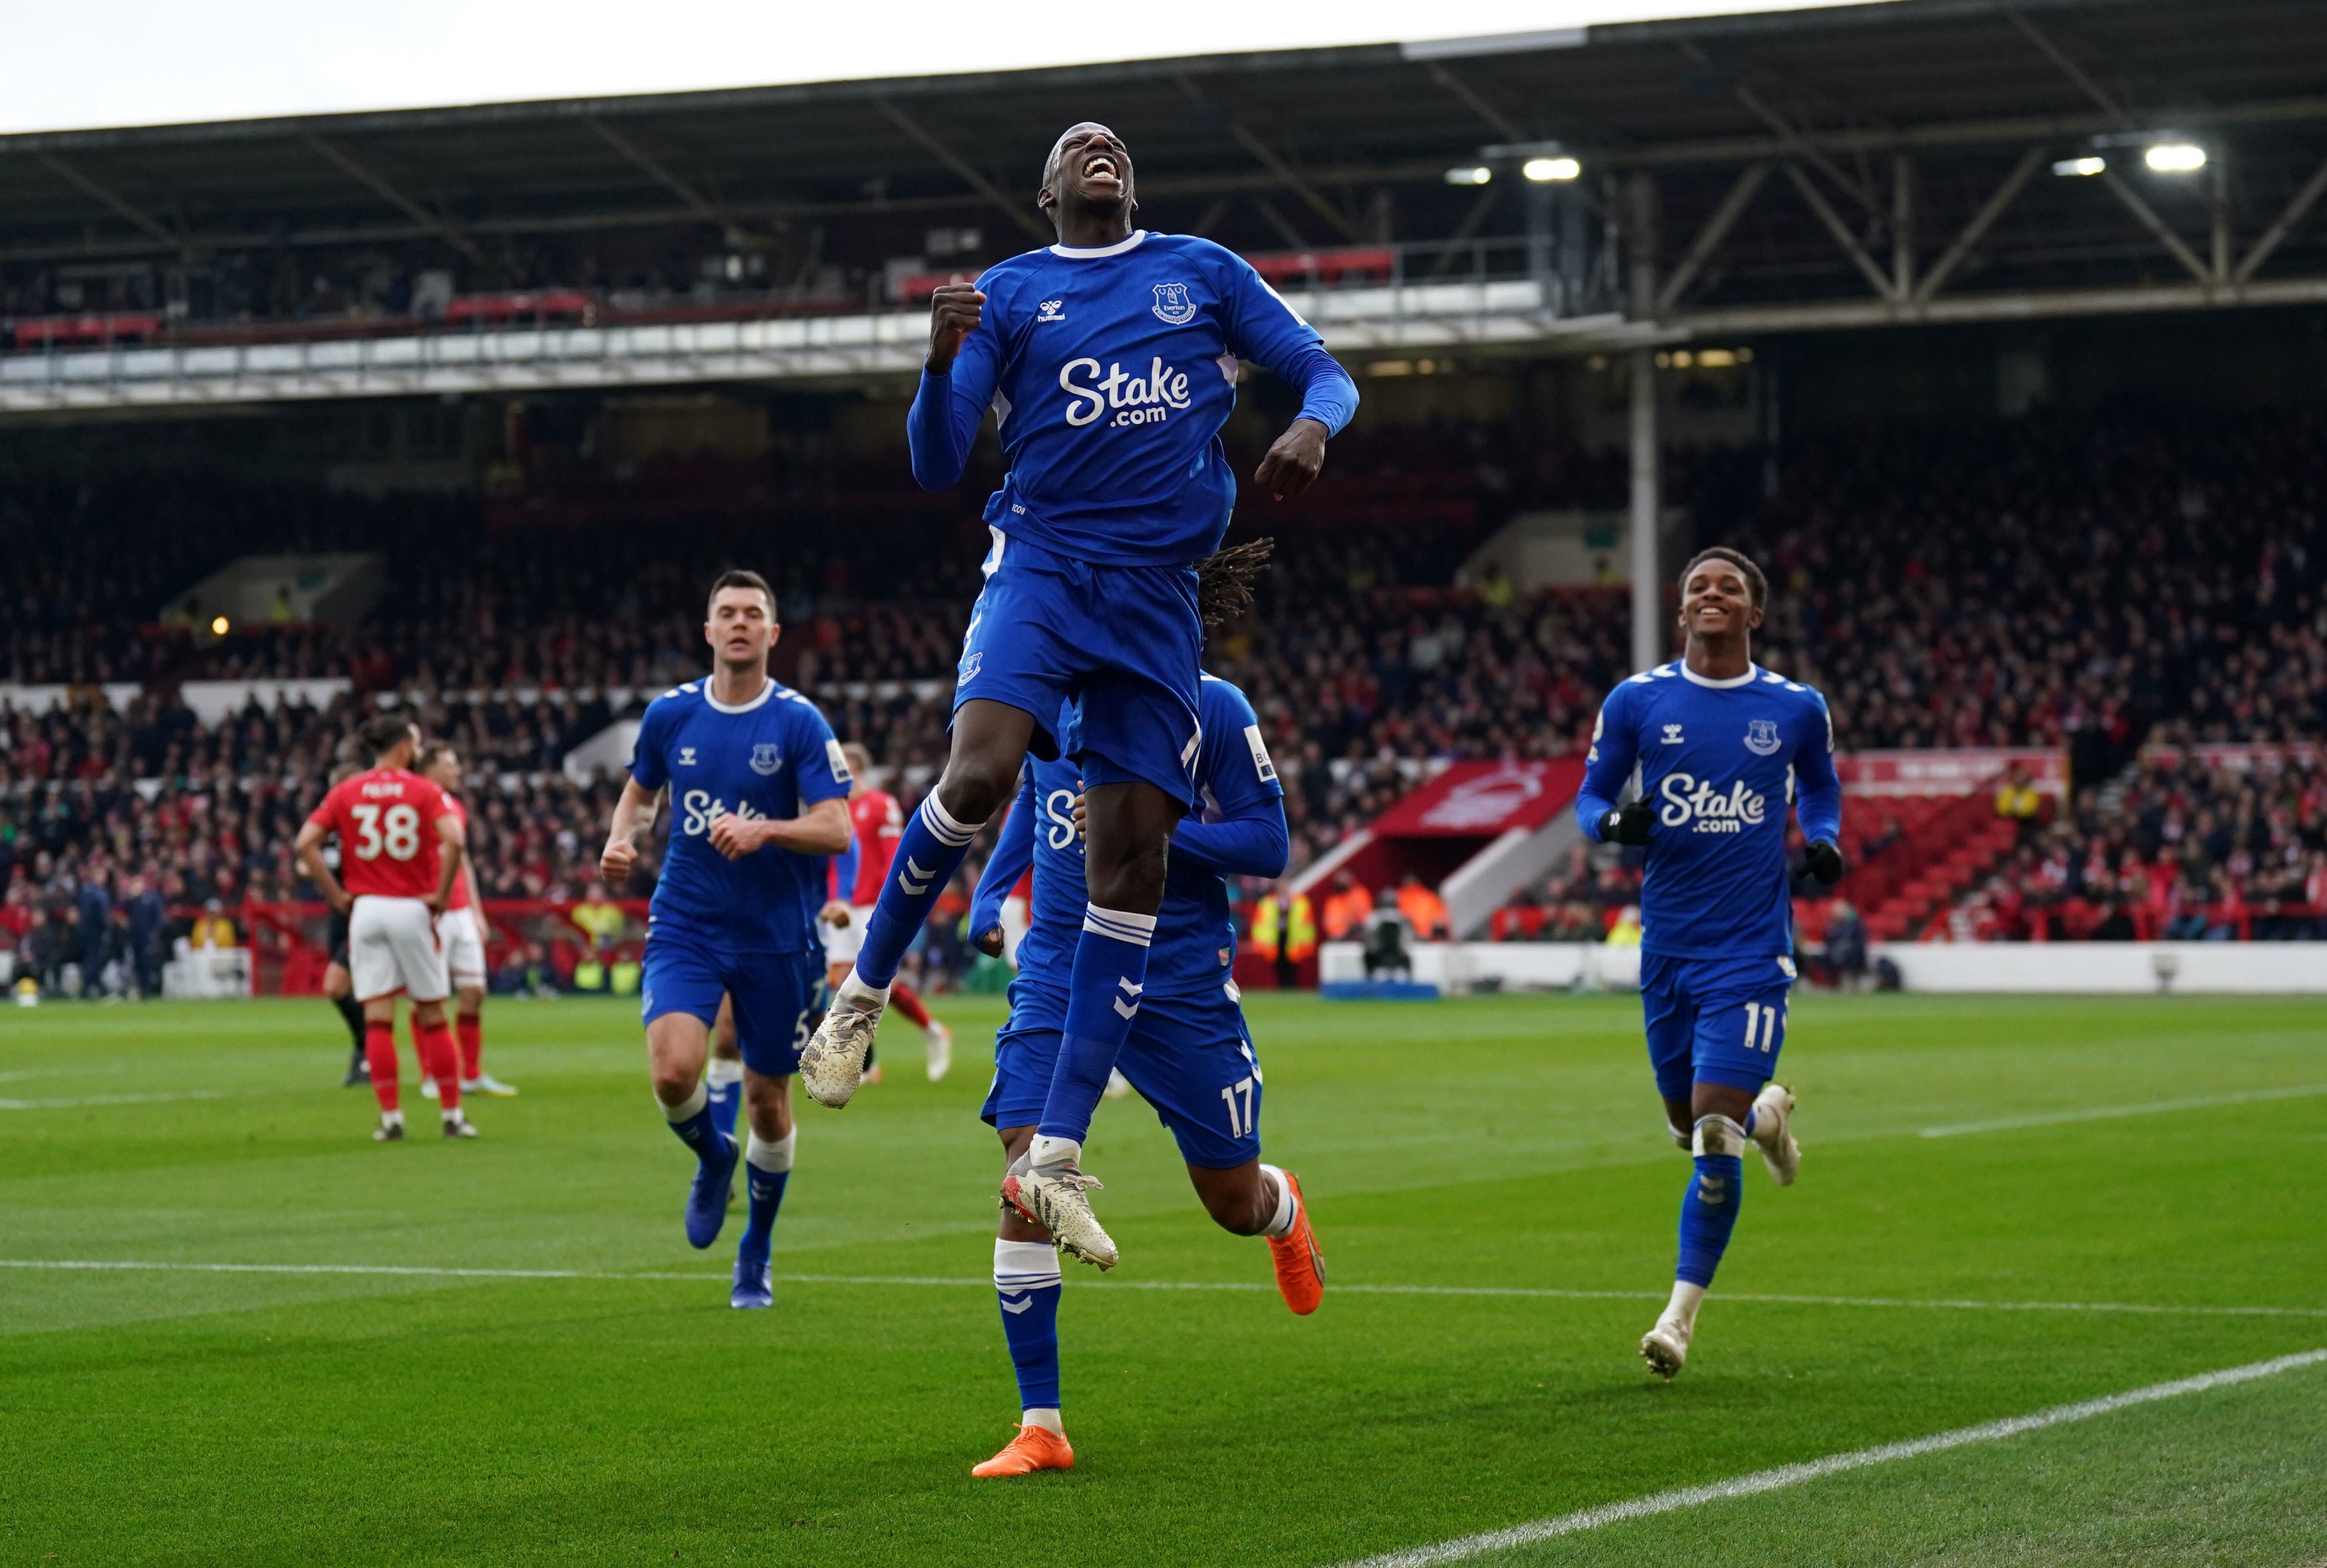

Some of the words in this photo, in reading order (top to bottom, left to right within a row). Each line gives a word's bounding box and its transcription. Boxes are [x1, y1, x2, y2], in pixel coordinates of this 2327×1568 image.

[1038, 313, 1066, 322] hummel
[1059, 356, 1191, 426] Stake
[1110, 406, 1167, 428] .com
[1661, 772, 1765, 827] Stake
[351, 804, 420, 861] 38
[1692, 819, 1741, 834] .com
[792, 1008, 810, 1050] 5
[1744, 1001, 1776, 1054] 11
[1221, 1076, 1253, 1139] 17
